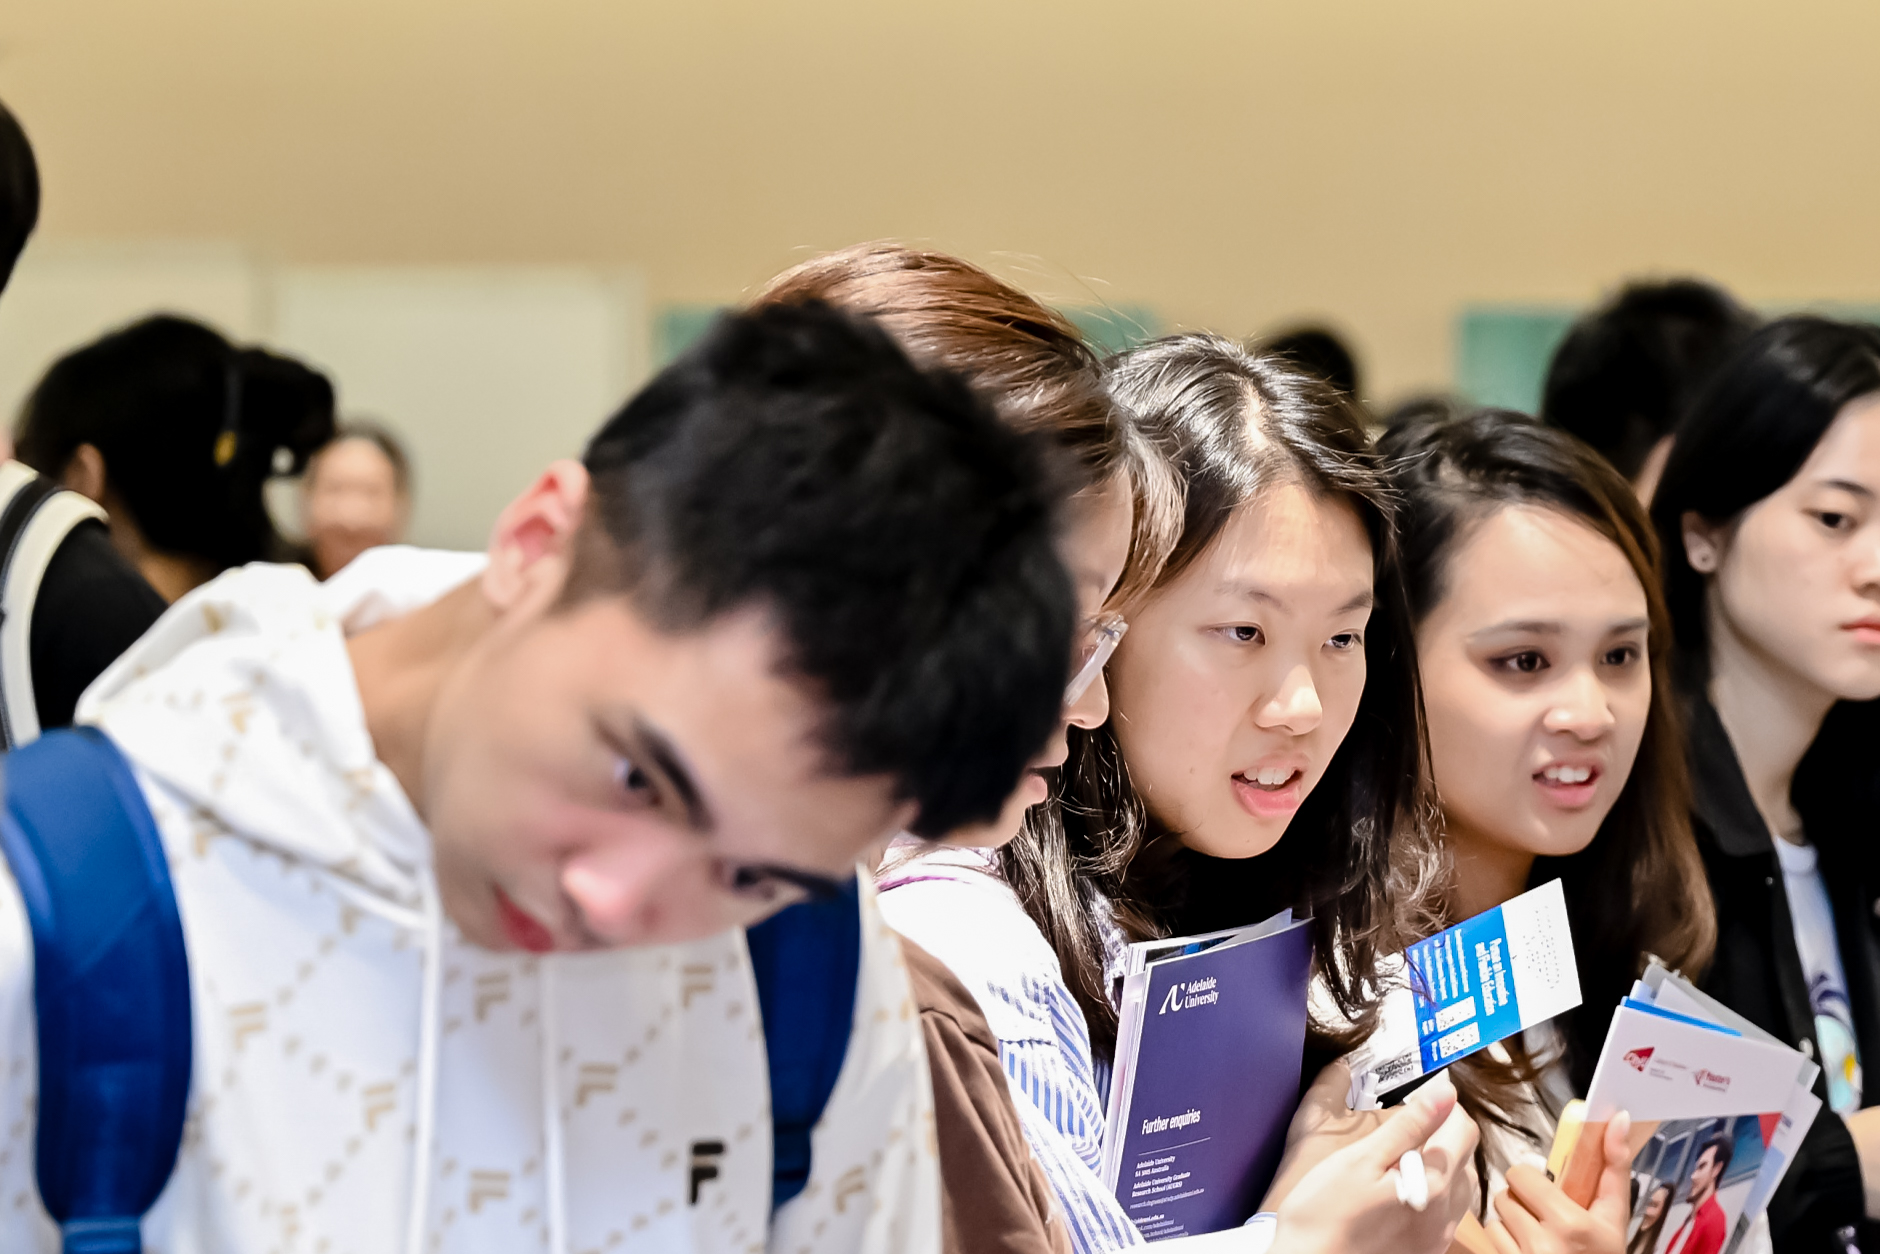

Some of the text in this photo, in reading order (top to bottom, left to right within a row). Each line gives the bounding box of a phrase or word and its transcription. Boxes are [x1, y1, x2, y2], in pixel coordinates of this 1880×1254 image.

[1186, 976, 1217, 994] Adelaide
[1184, 990, 1219, 1009] University
[1141, 1108, 1201, 1135] Further enquiries
